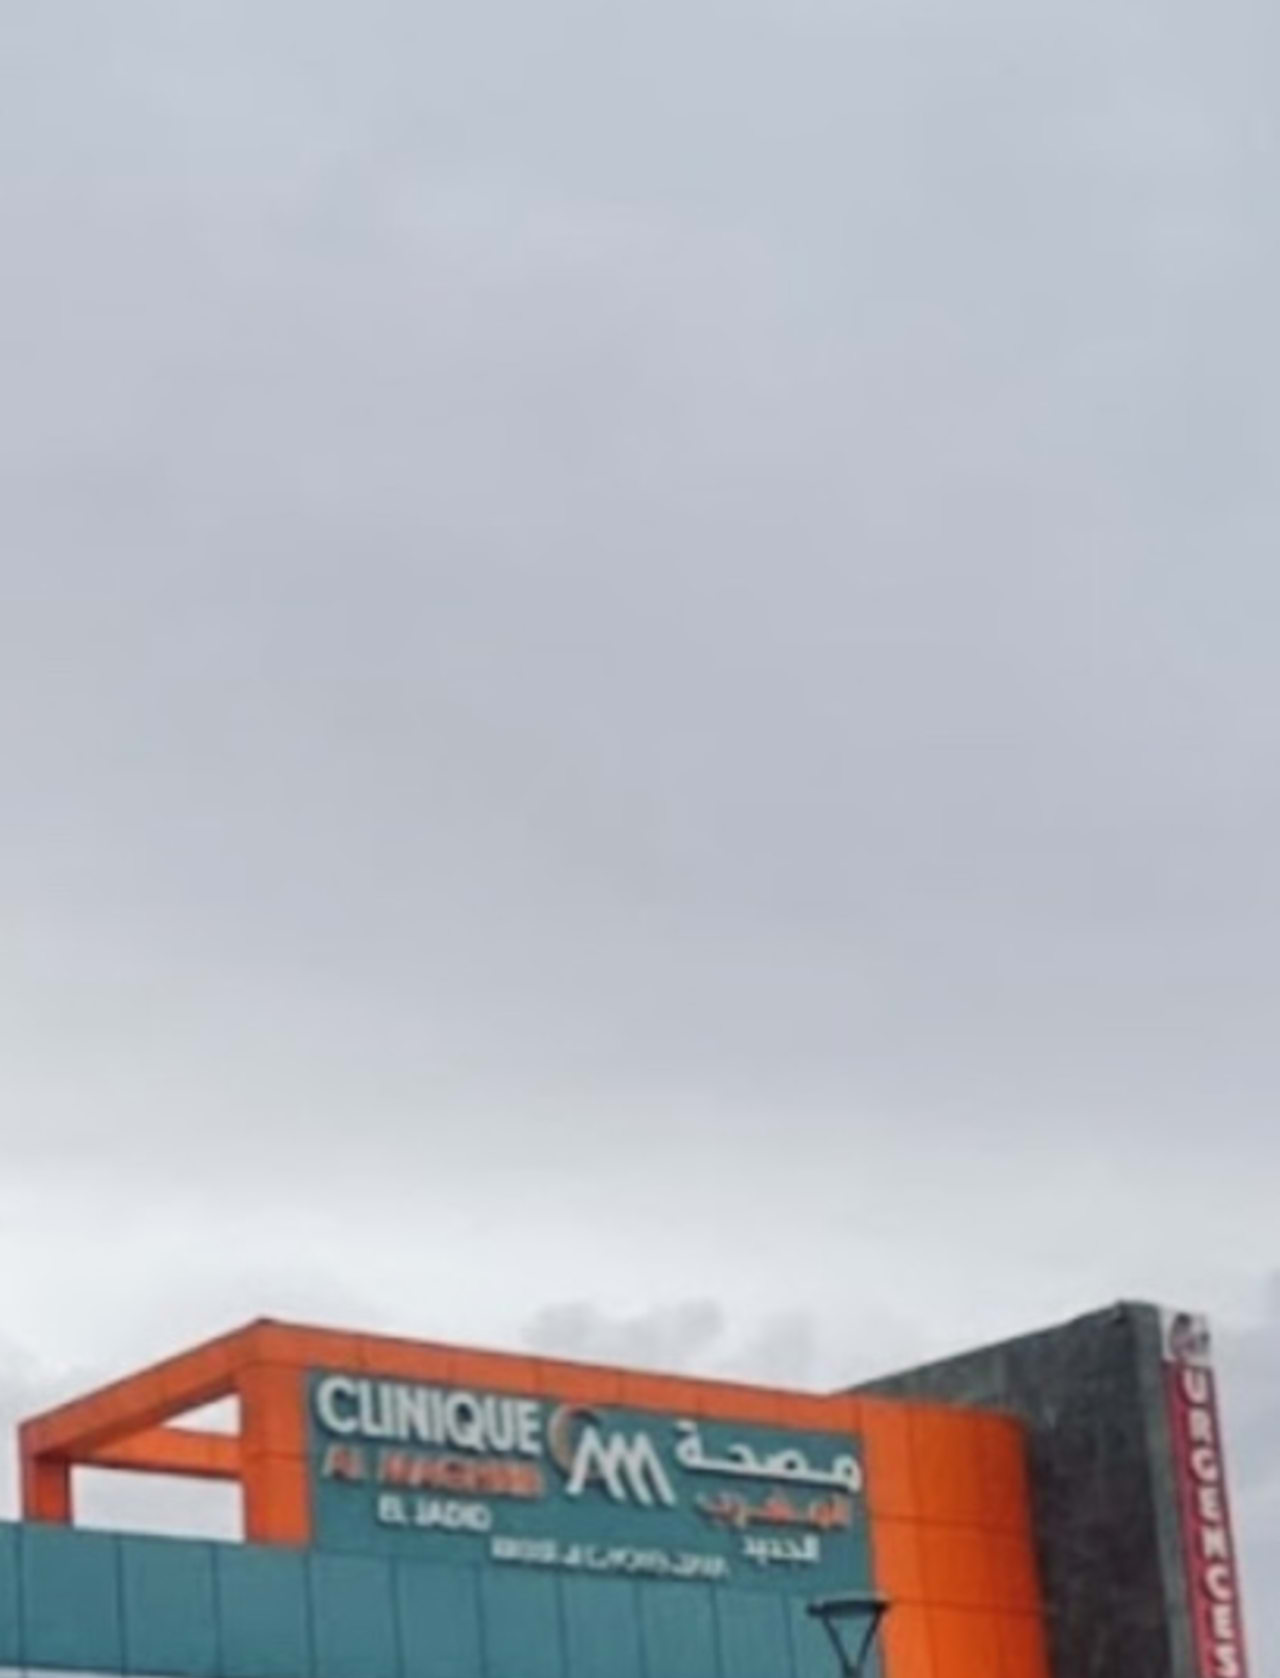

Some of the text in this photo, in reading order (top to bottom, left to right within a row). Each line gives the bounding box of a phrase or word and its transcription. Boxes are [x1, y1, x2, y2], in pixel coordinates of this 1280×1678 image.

[317, 1375, 543, 1452] CLINIQUE
[675, 1418, 862, 1493] مصحة
[378, 1493, 407, 1524] EL
